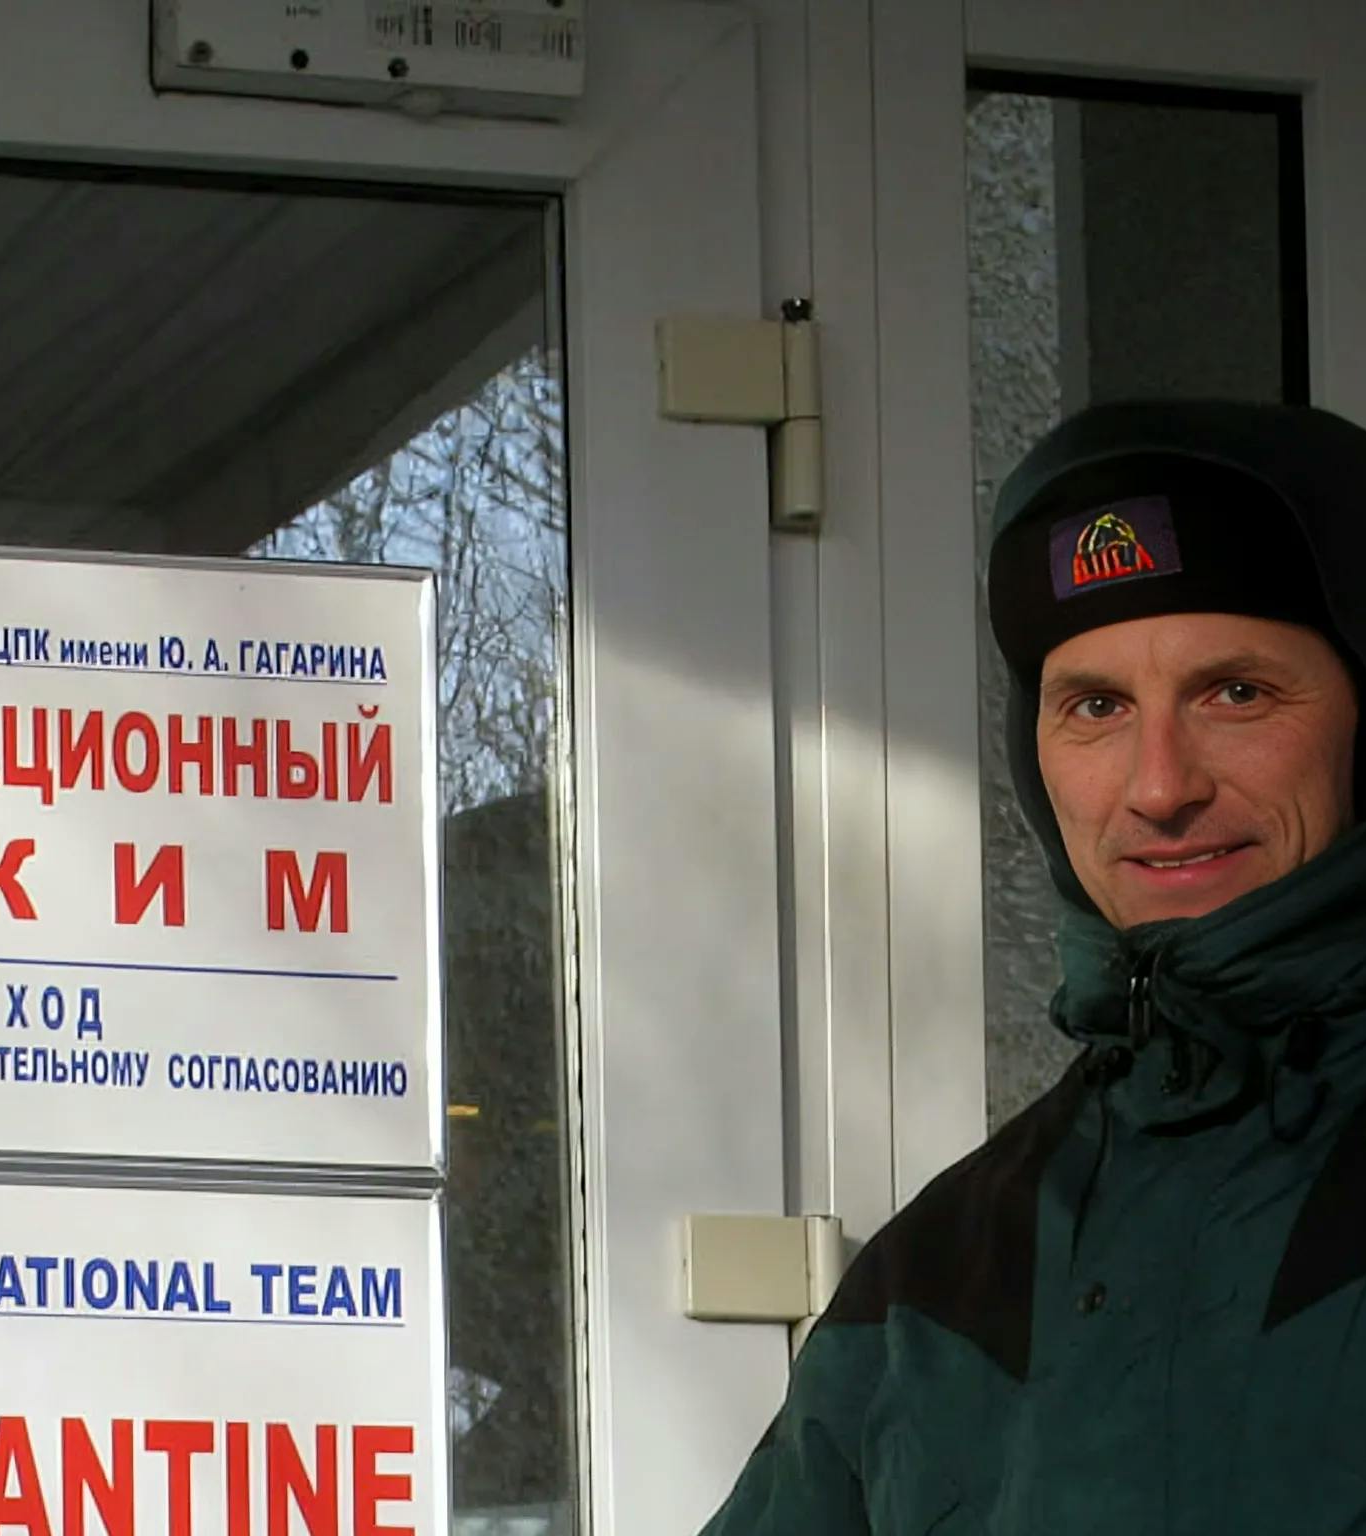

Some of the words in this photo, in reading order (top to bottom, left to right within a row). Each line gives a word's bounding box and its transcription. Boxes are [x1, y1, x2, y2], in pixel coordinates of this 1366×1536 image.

[60, 638, 148, 667] имени
[159, 636, 192, 670] Ю.
[203, 639, 229, 672] А.
[239, 640, 387, 679] ГАГАРИНА
[168, 1053, 408, 1097] СОГЛАСОВАНИЮ
[250, 1263, 403, 1319] TEAM
